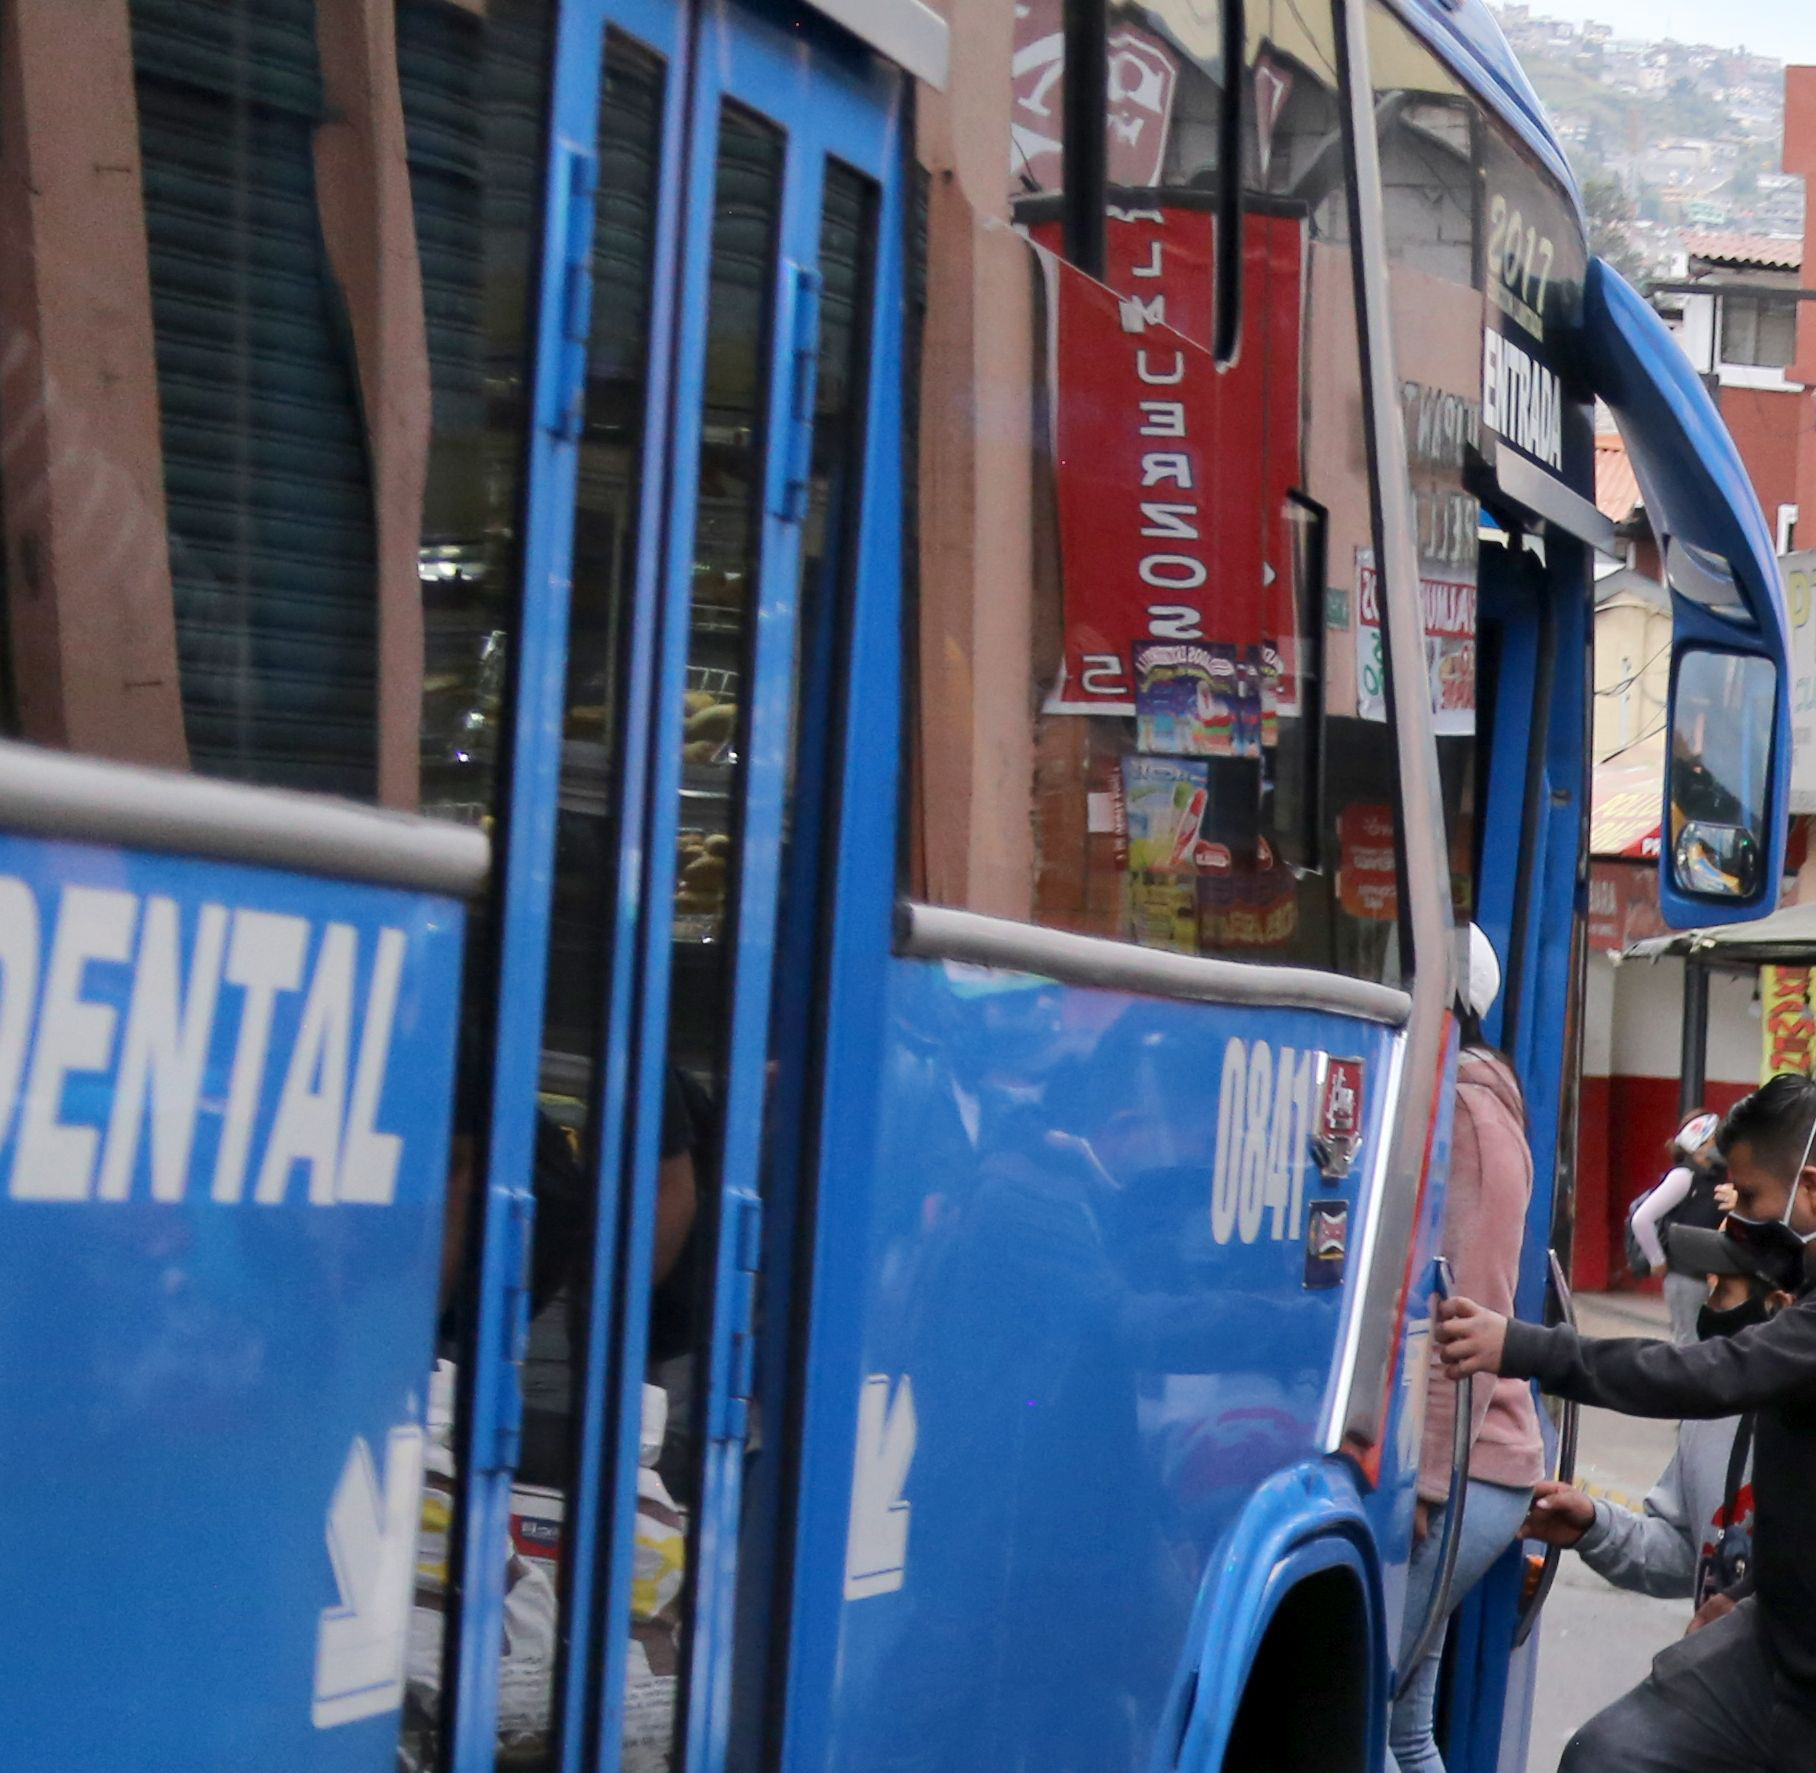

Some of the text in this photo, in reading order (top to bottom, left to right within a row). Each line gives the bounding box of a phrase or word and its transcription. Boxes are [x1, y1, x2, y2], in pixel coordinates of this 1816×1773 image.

[1487, 193, 1554, 317] 2017
[1483, 325, 1563, 473] ENTRADA
[1211, 1036, 1313, 1245] 0841
